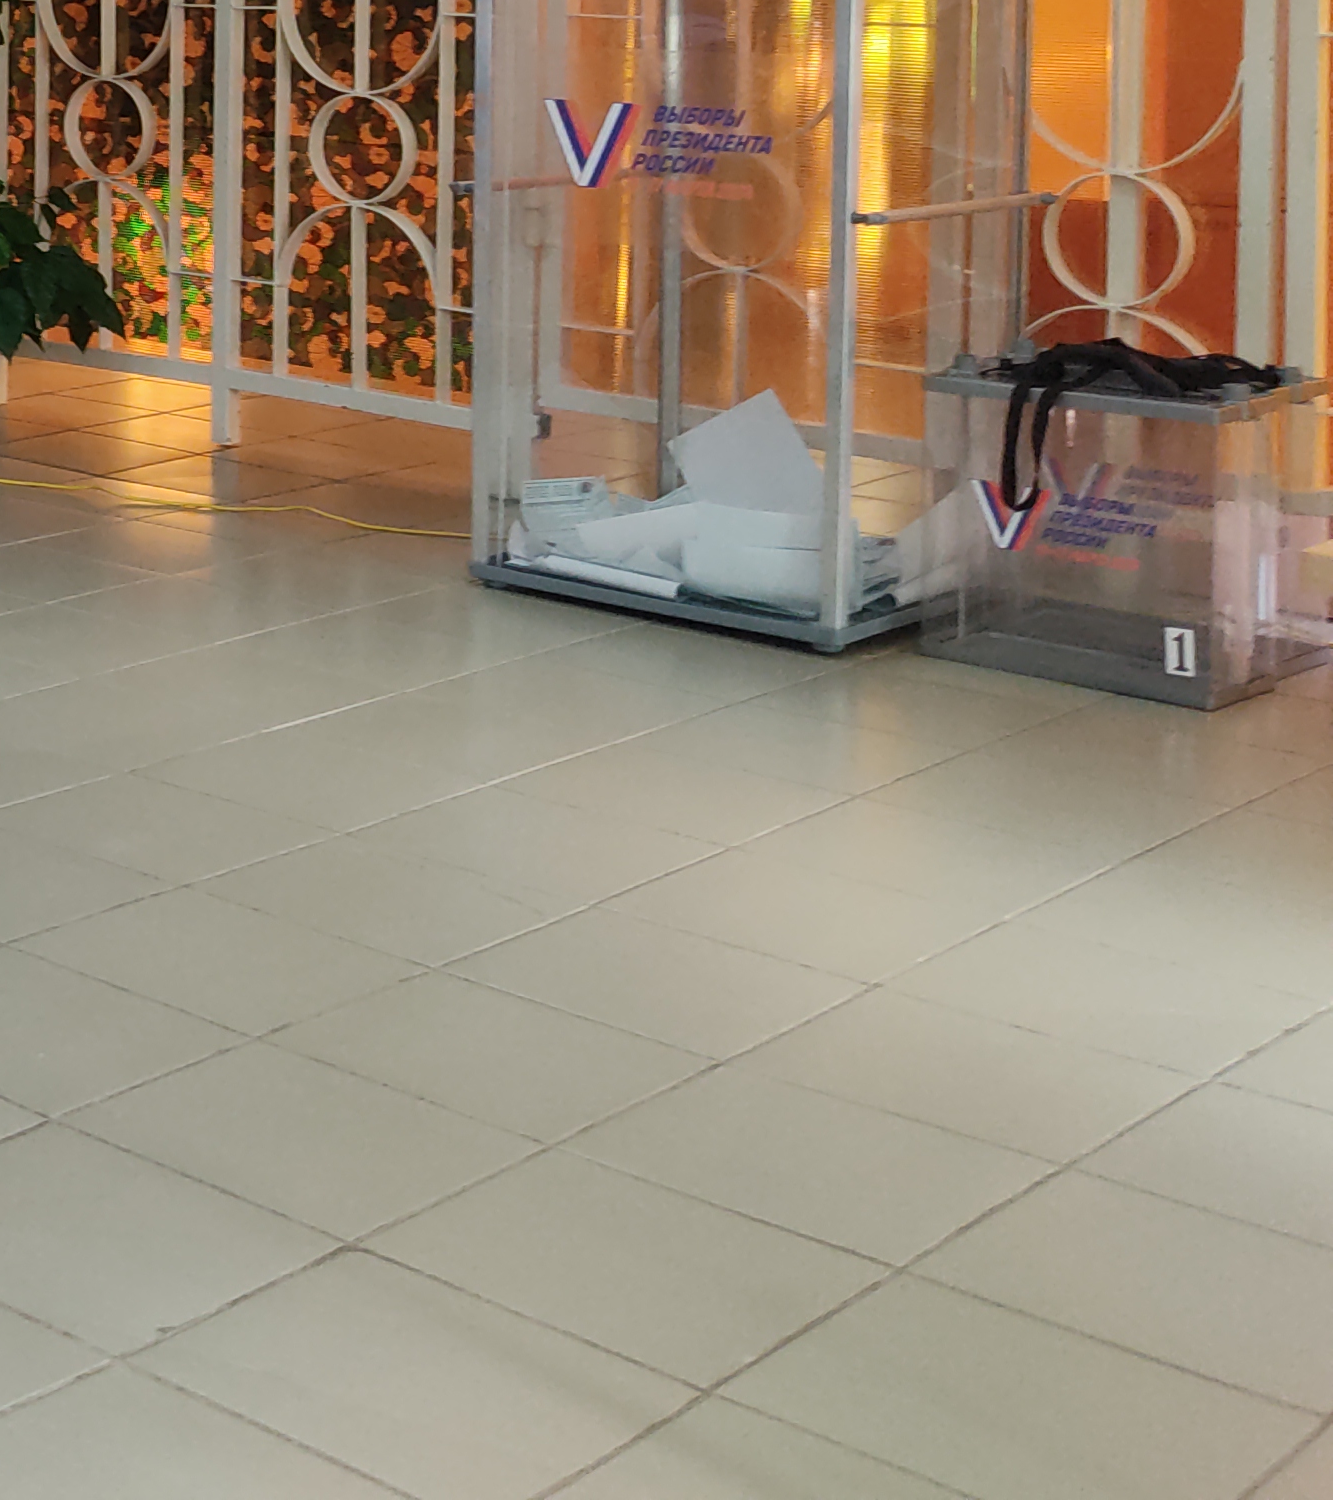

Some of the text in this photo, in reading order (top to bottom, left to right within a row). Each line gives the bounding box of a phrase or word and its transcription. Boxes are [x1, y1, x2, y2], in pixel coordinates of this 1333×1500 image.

[653, 104, 746, 129] ВЫБОРЫ
[641, 128, 775, 155] ПРЕЗИДЕНТА
[633, 152, 716, 176] РОССИИ
[1172, 631, 1191, 673] 1
